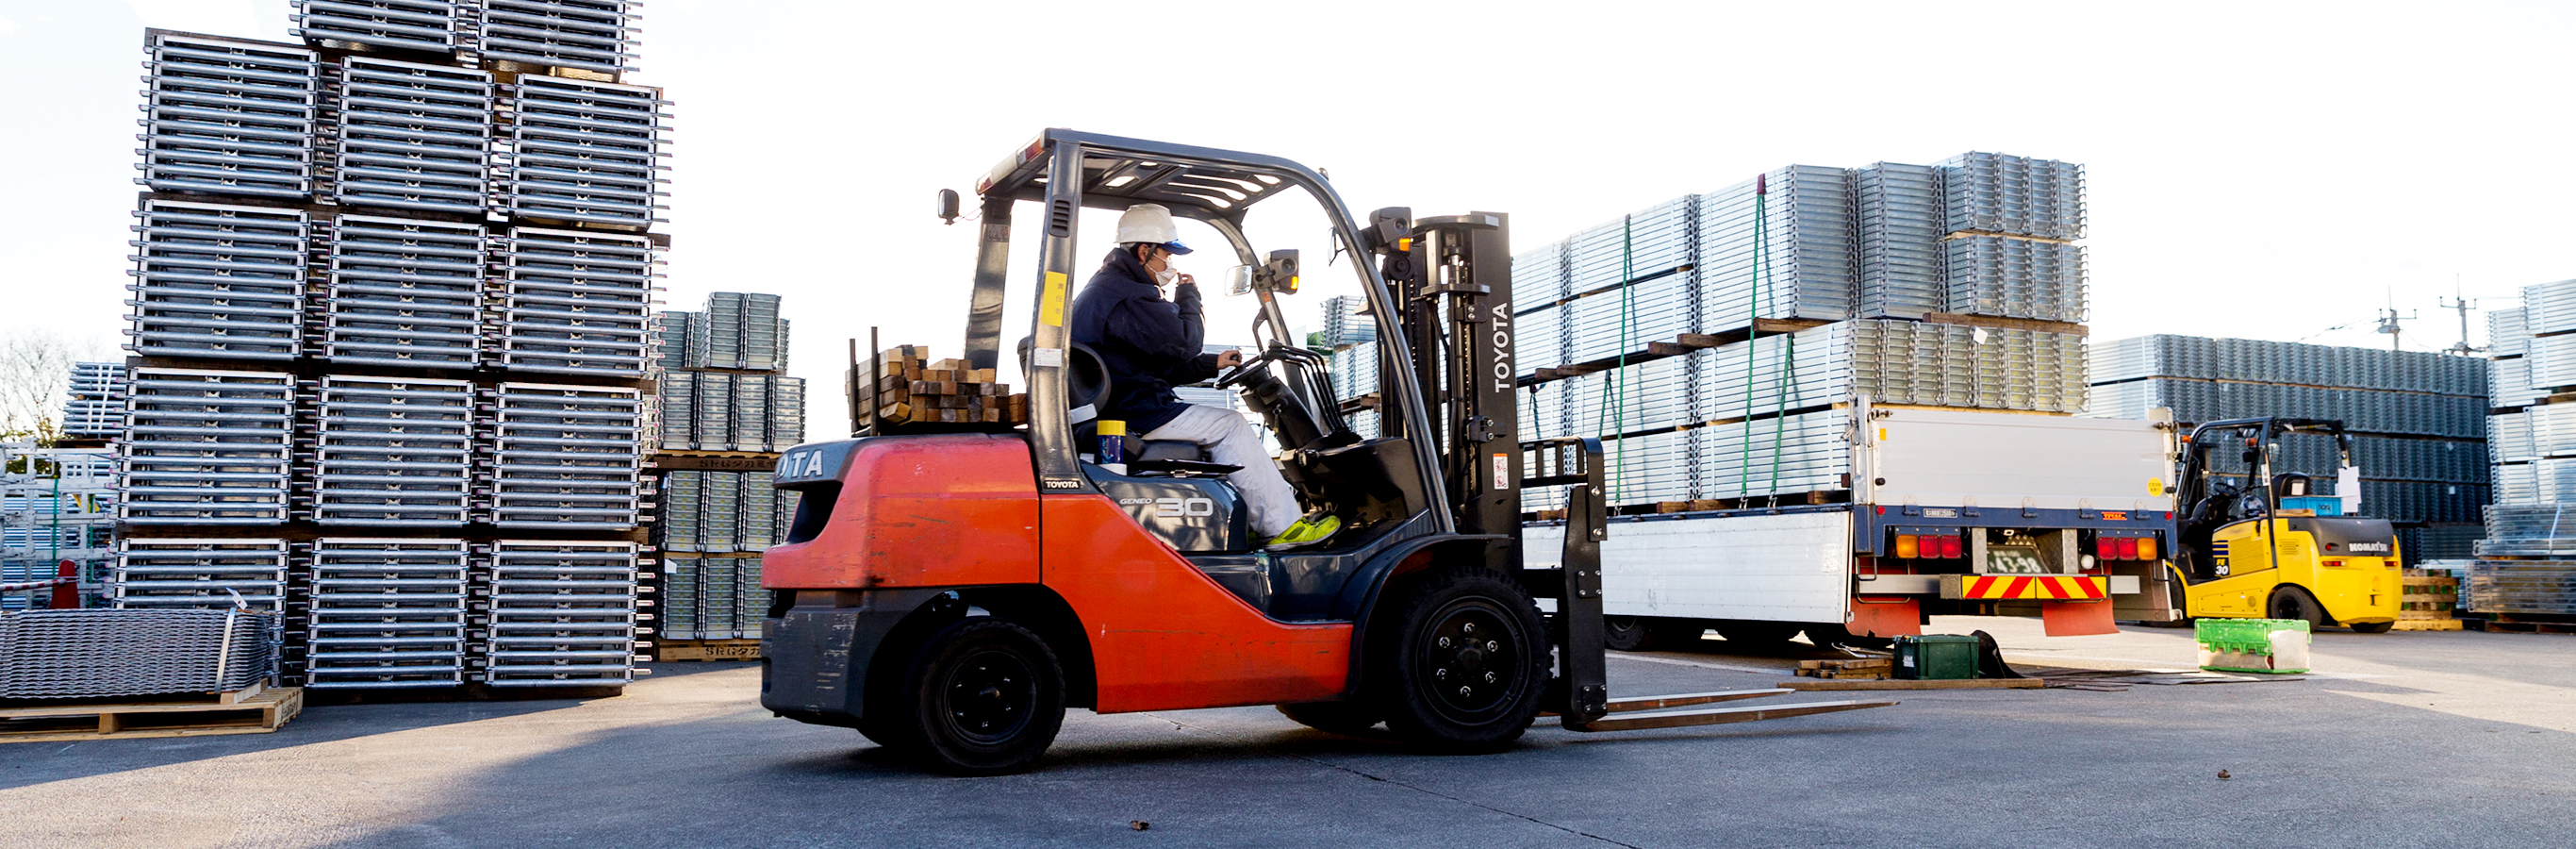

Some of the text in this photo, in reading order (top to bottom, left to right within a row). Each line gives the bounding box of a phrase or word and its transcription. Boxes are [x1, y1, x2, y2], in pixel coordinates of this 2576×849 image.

[1493, 303, 1511, 392] TOYOTA
[1046, 480, 1079, 489] TOYOTA
[1156, 497, 1214, 517] 30
[2348, 541, 2388, 552] KOMATSU
[2215, 565, 2229, 575] 30
